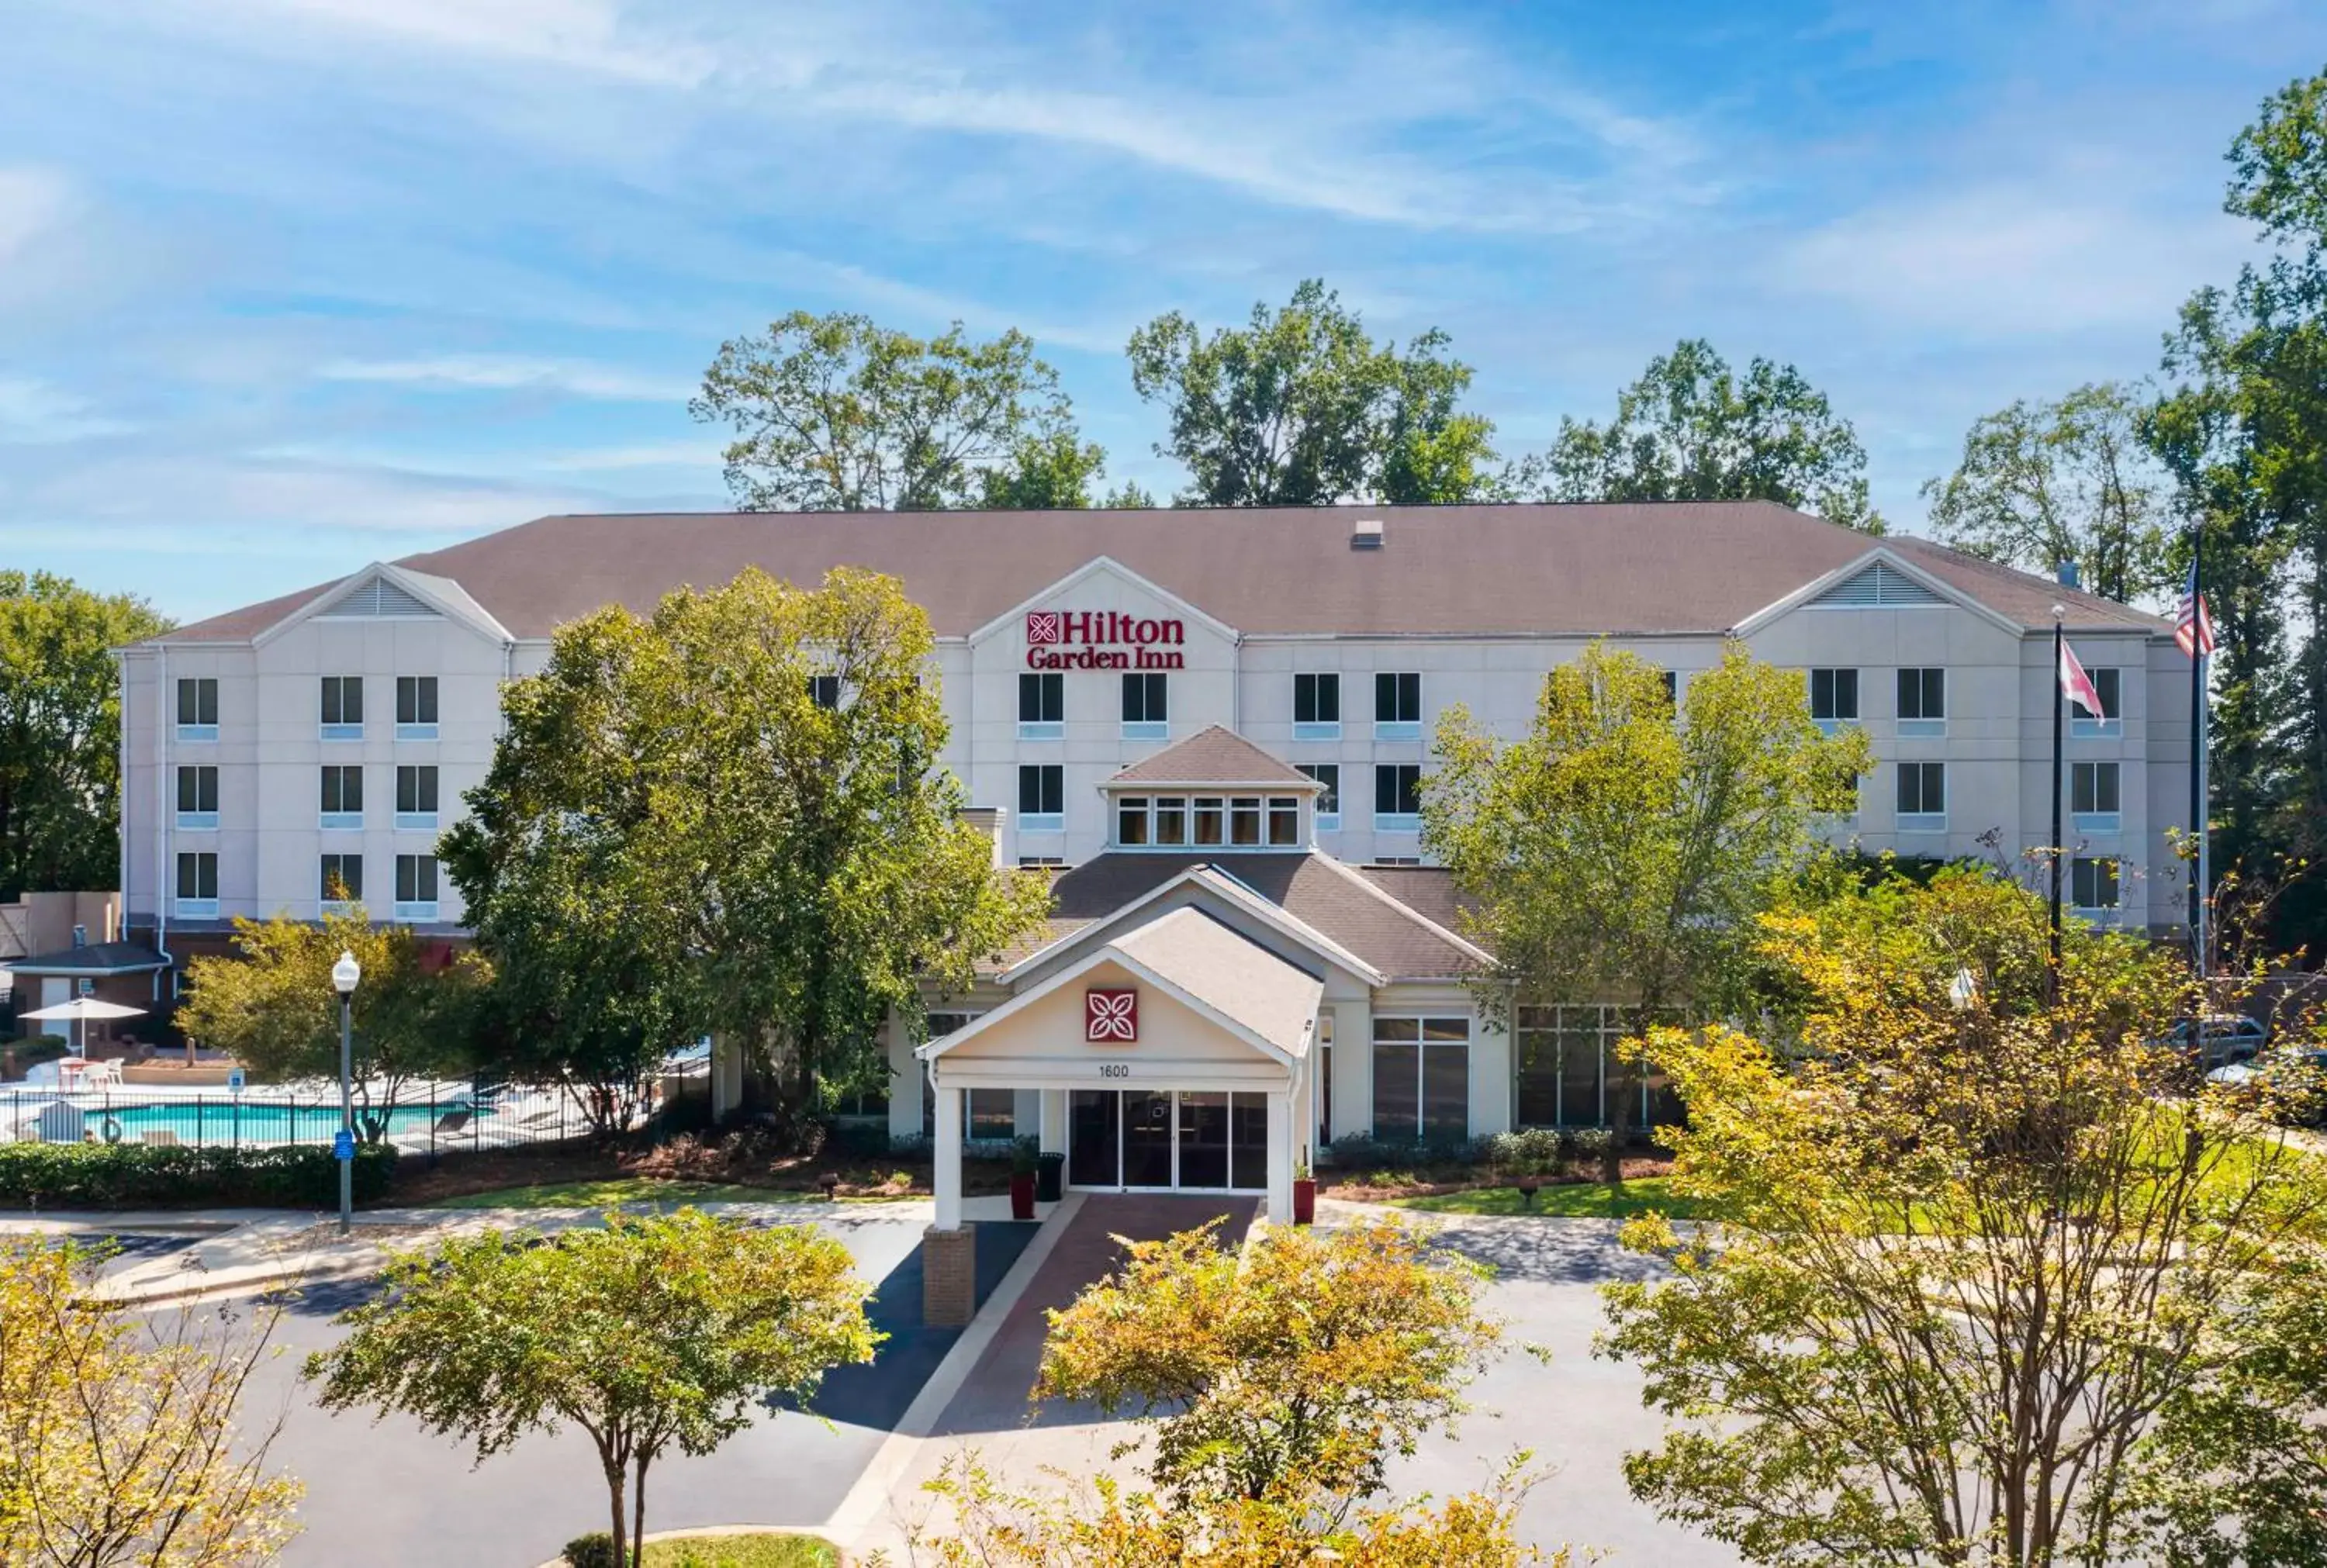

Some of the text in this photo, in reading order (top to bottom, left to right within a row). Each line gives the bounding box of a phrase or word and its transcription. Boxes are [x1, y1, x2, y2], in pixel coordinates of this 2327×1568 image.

[1062, 611, 1184, 645] Hilton
[1027, 646, 1184, 669] Garden Inn
[1100, 1065, 1129, 1077] 1600
